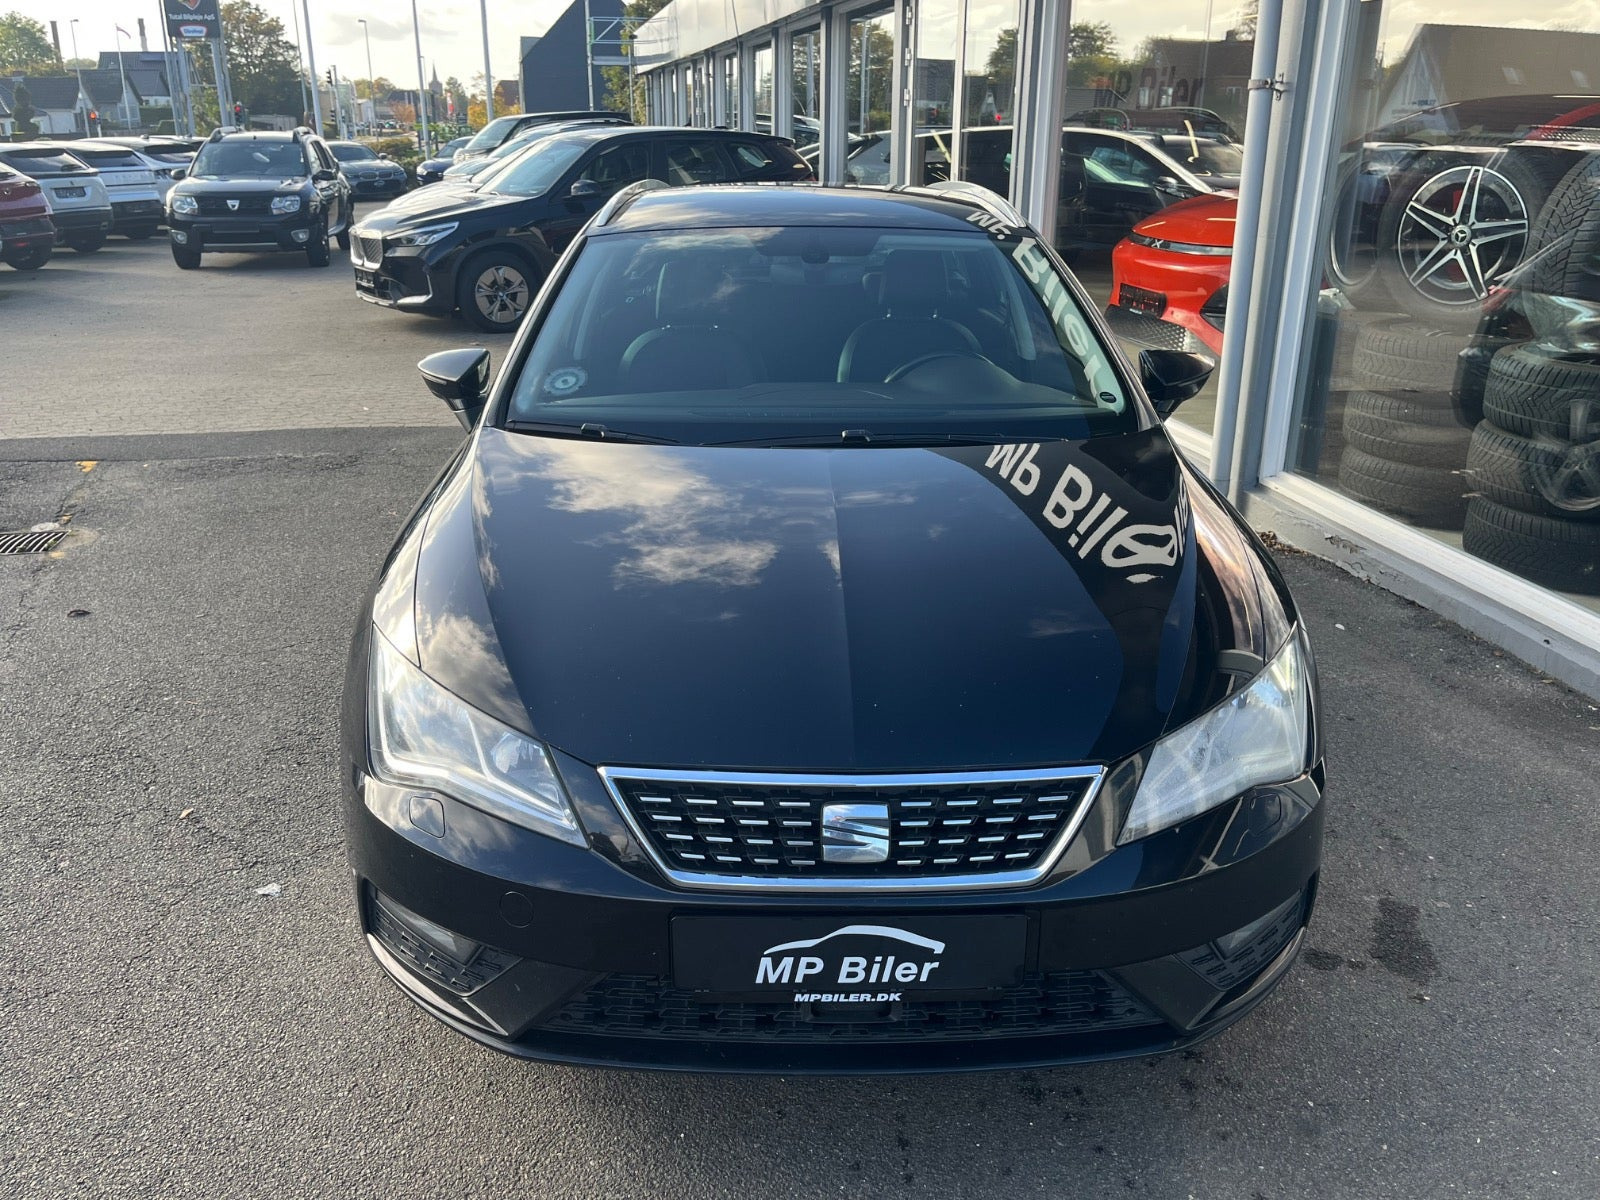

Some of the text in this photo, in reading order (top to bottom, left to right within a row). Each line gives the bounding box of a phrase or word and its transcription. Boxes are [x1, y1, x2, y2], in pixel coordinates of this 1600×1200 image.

[755, 955, 940, 984] MP Biler
[794, 992, 903, 1002] MPBILER.DK
